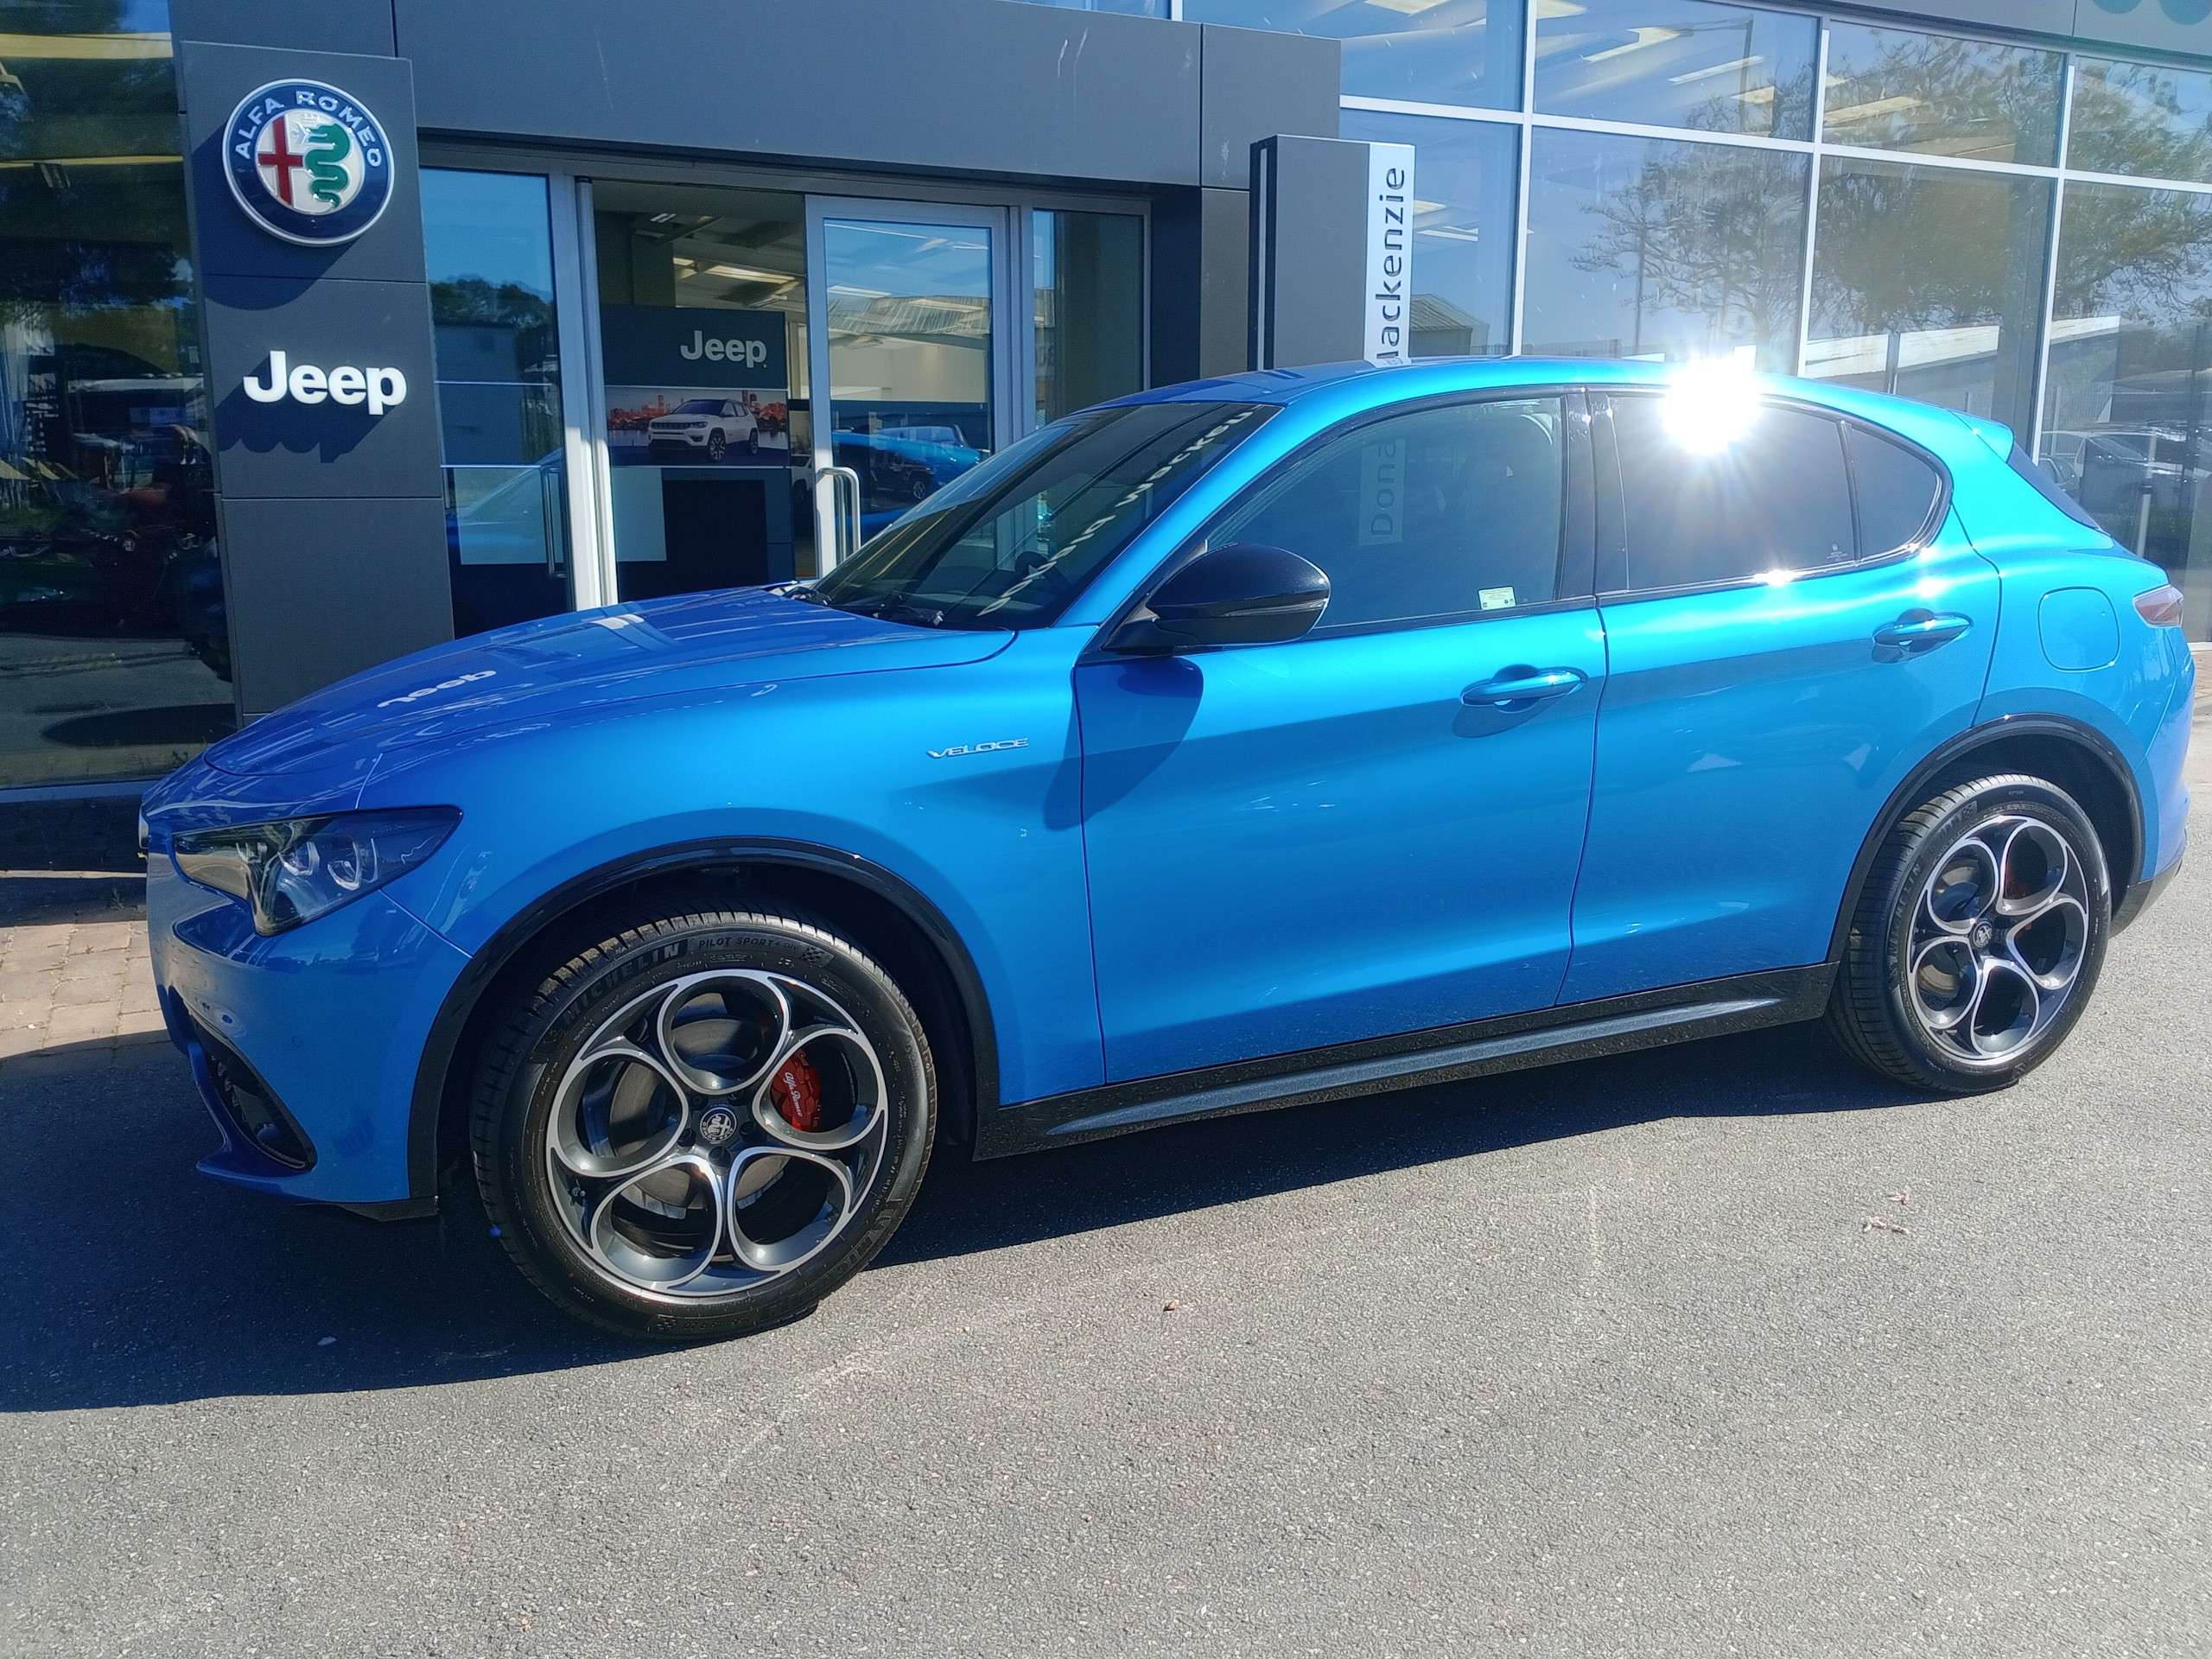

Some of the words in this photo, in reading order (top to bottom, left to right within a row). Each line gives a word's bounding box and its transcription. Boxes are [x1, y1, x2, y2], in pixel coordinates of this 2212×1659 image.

[235, 96, 285, 161] ALFA
[296, 90, 382, 168] ROMEO
[680, 330, 767, 368] Jeep
[243, 350, 407, 415] Jeep
[926, 738, 1029, 759] VELOCE
[699, 937, 729, 948] PILOT
[737, 937, 775, 947] SPORT
[563, 942, 680, 1023] MICHELIN
